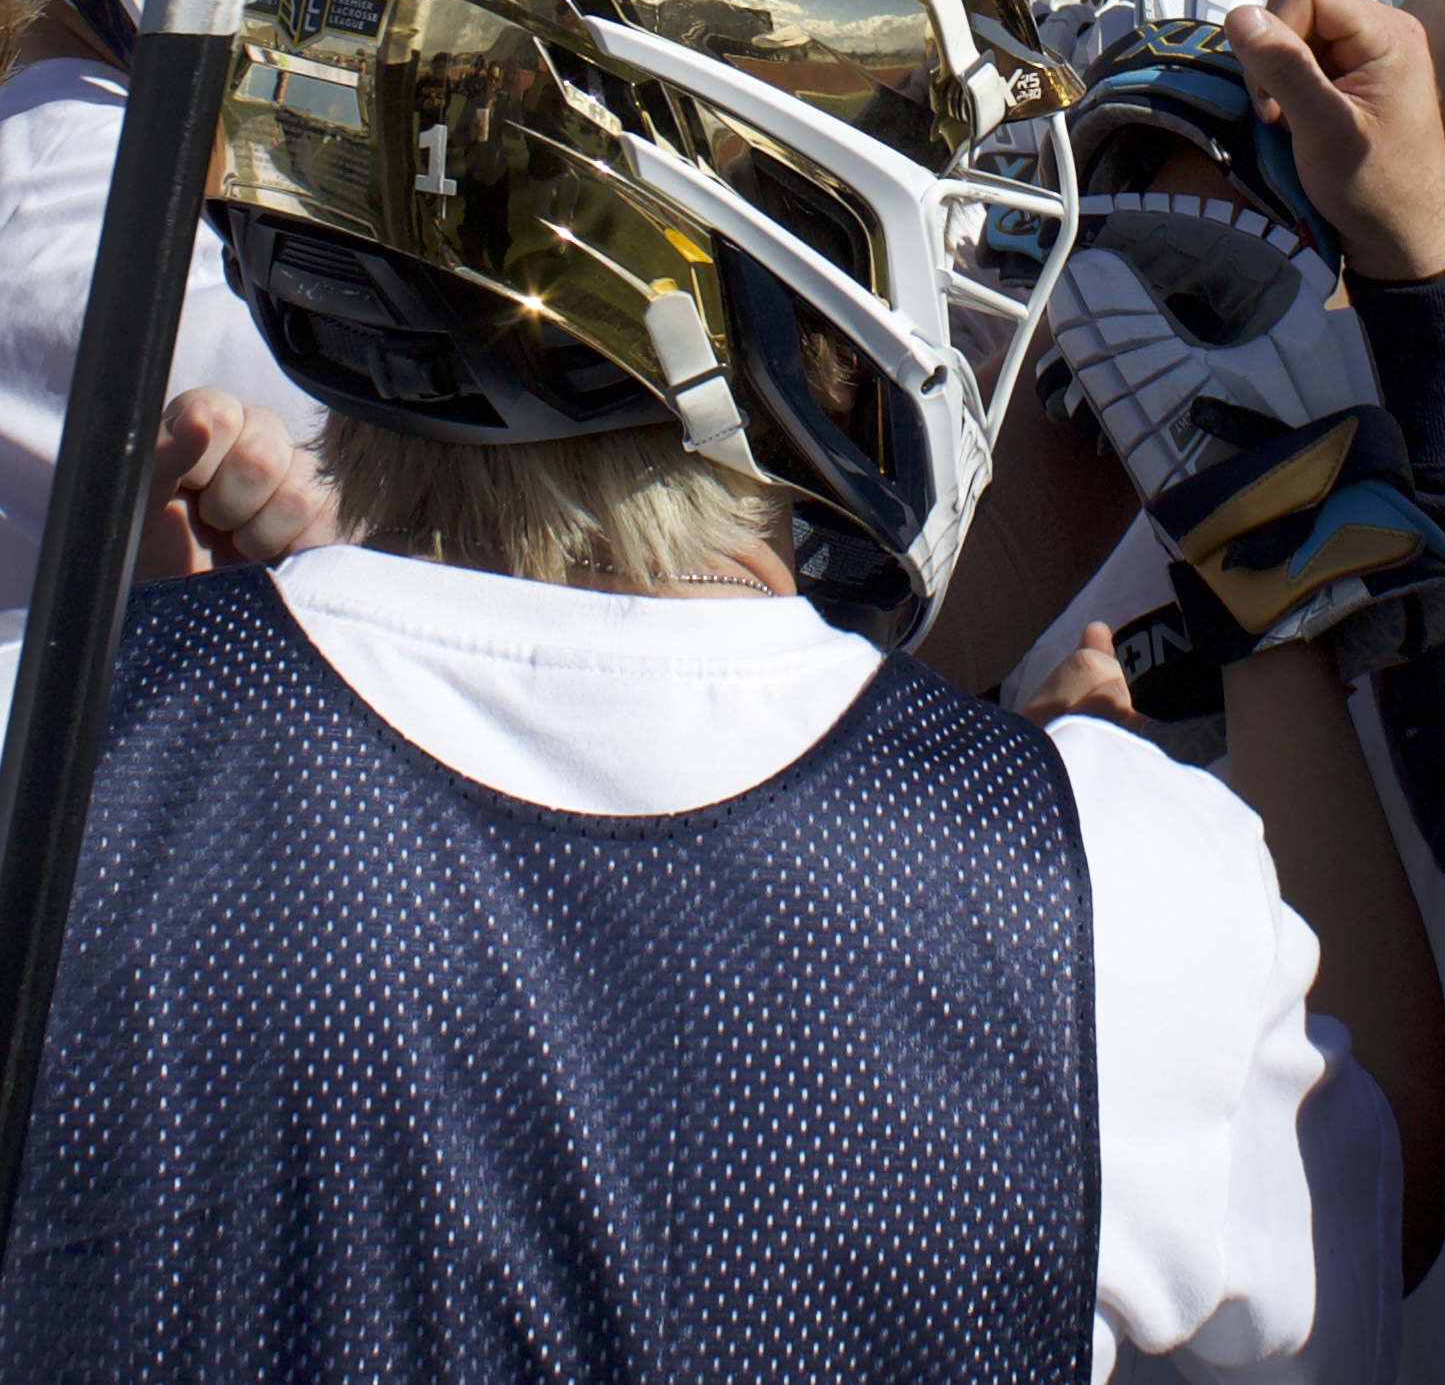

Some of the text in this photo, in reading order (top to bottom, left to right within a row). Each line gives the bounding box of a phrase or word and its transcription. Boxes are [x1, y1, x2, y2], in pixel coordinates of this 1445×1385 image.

[331, 5, 379, 23] LACROSSE
[329, 17, 365, 30] LEAGUE
[415, 123, 458, 197] 1
